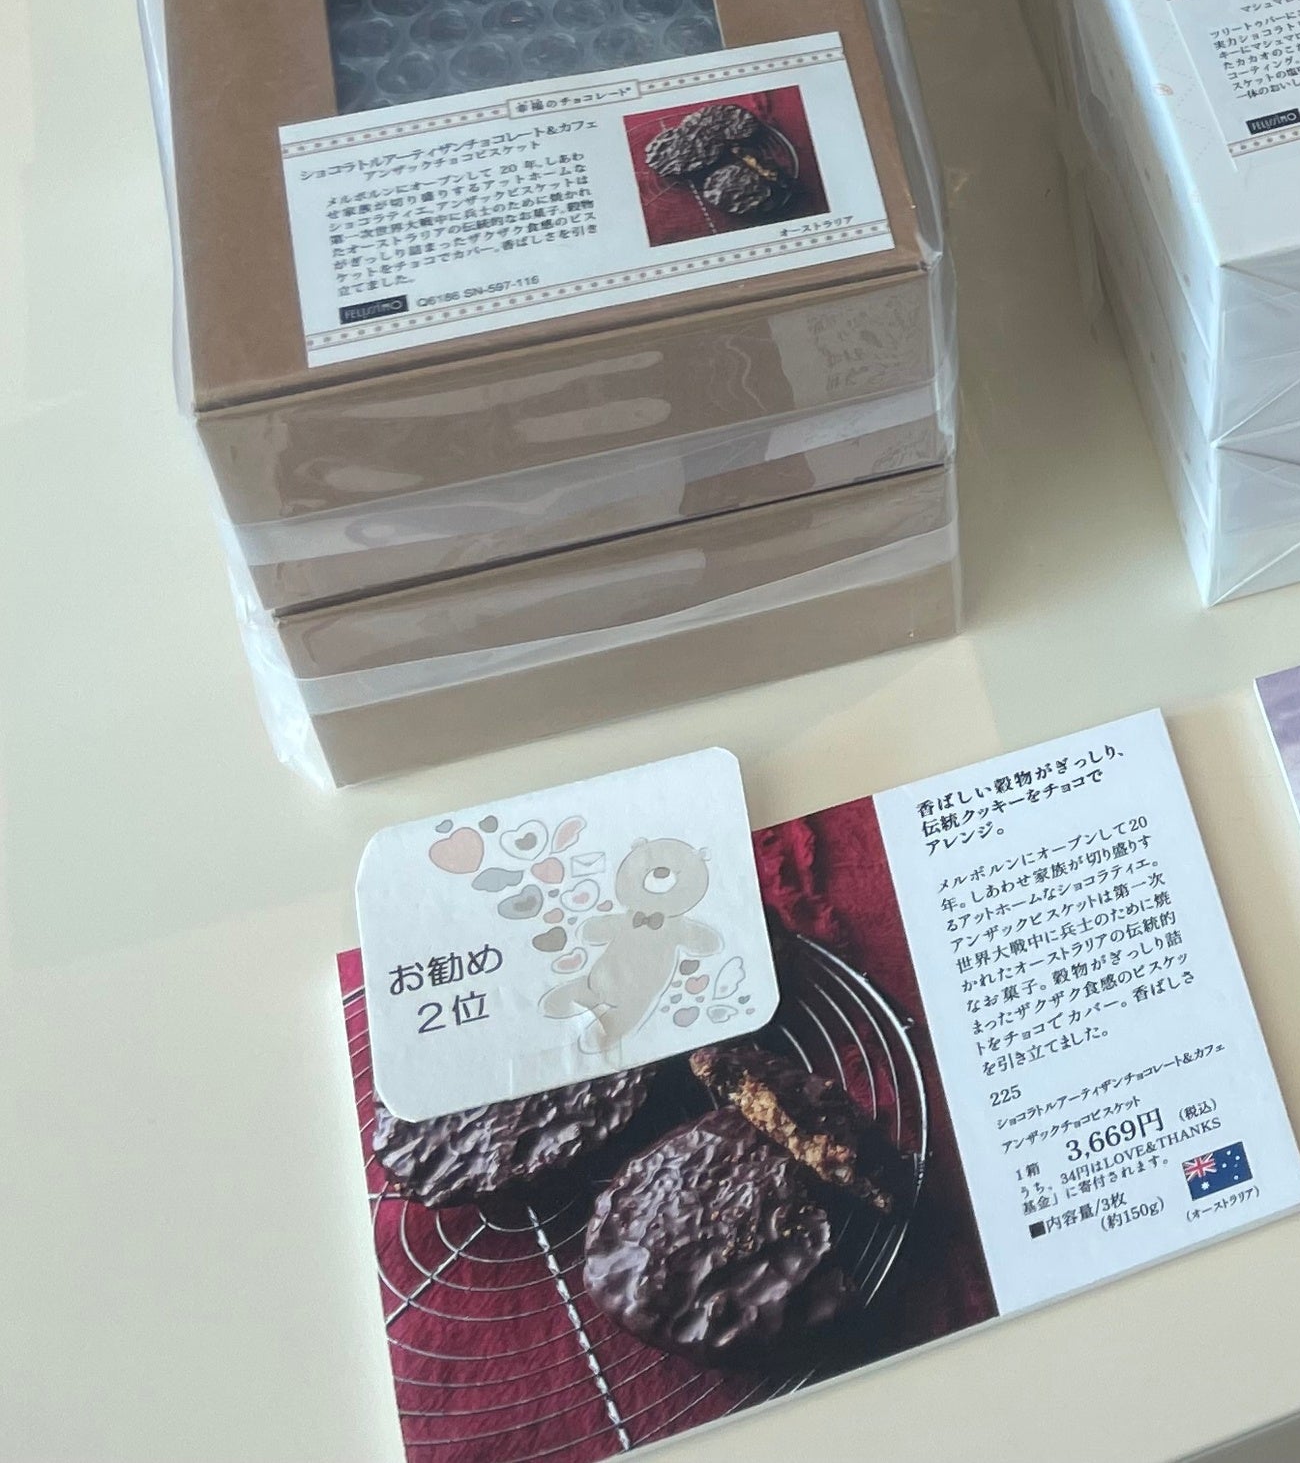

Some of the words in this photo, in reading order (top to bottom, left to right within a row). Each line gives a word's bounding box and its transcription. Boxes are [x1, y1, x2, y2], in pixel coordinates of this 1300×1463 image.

[363, 140, 541, 181] アンザックチョコビスケット
[916, 744, 1124, 819] 香ばしい穀物がぎっしり、
[921, 768, 1104, 838] 伝統クッキーをチョコで
[925, 821, 1005, 857] アレンジ。
[938, 815, 1148, 894] メルボルンにオープンして20
[940, 834, 1152, 913] 年。しあわせ家族が切り盛りす
[946, 858, 1159, 932] るアットホームなショコラティエ。
[950, 872, 1166, 953] アンザックビスケットは第一次
[388, 942, 504, 997] お勧め
[955, 890, 1172, 975] 世界大戦中に兵士のために焼
[961, 910, 1176, 993] かれたオーストラリアの伝統的
[966, 930, 1183, 1014] なお菓子。穀物がぎっしり詰
[972, 953, 1188, 1036] まったザクザク食感のビスケッ
[976, 970, 1195, 1057] トをチョコでカバー。香ばしさ
[982, 1026, 1109, 1077] を引き立てました。
[997, 1044, 1225, 1130] ショコラトルアーティザンチョコレート&カフェ
[989, 1084, 1022, 1107] 225
[1001, 1095, 1141, 1154] アンザックチョコビスケット
[1065, 1107, 1164, 1162] 3,669円
[1178, 1098, 1217, 1122] (税込)
[1100, 1196, 1165, 1232] (約150g)
[1186, 1185, 1260, 1223] (オーストラリア)
